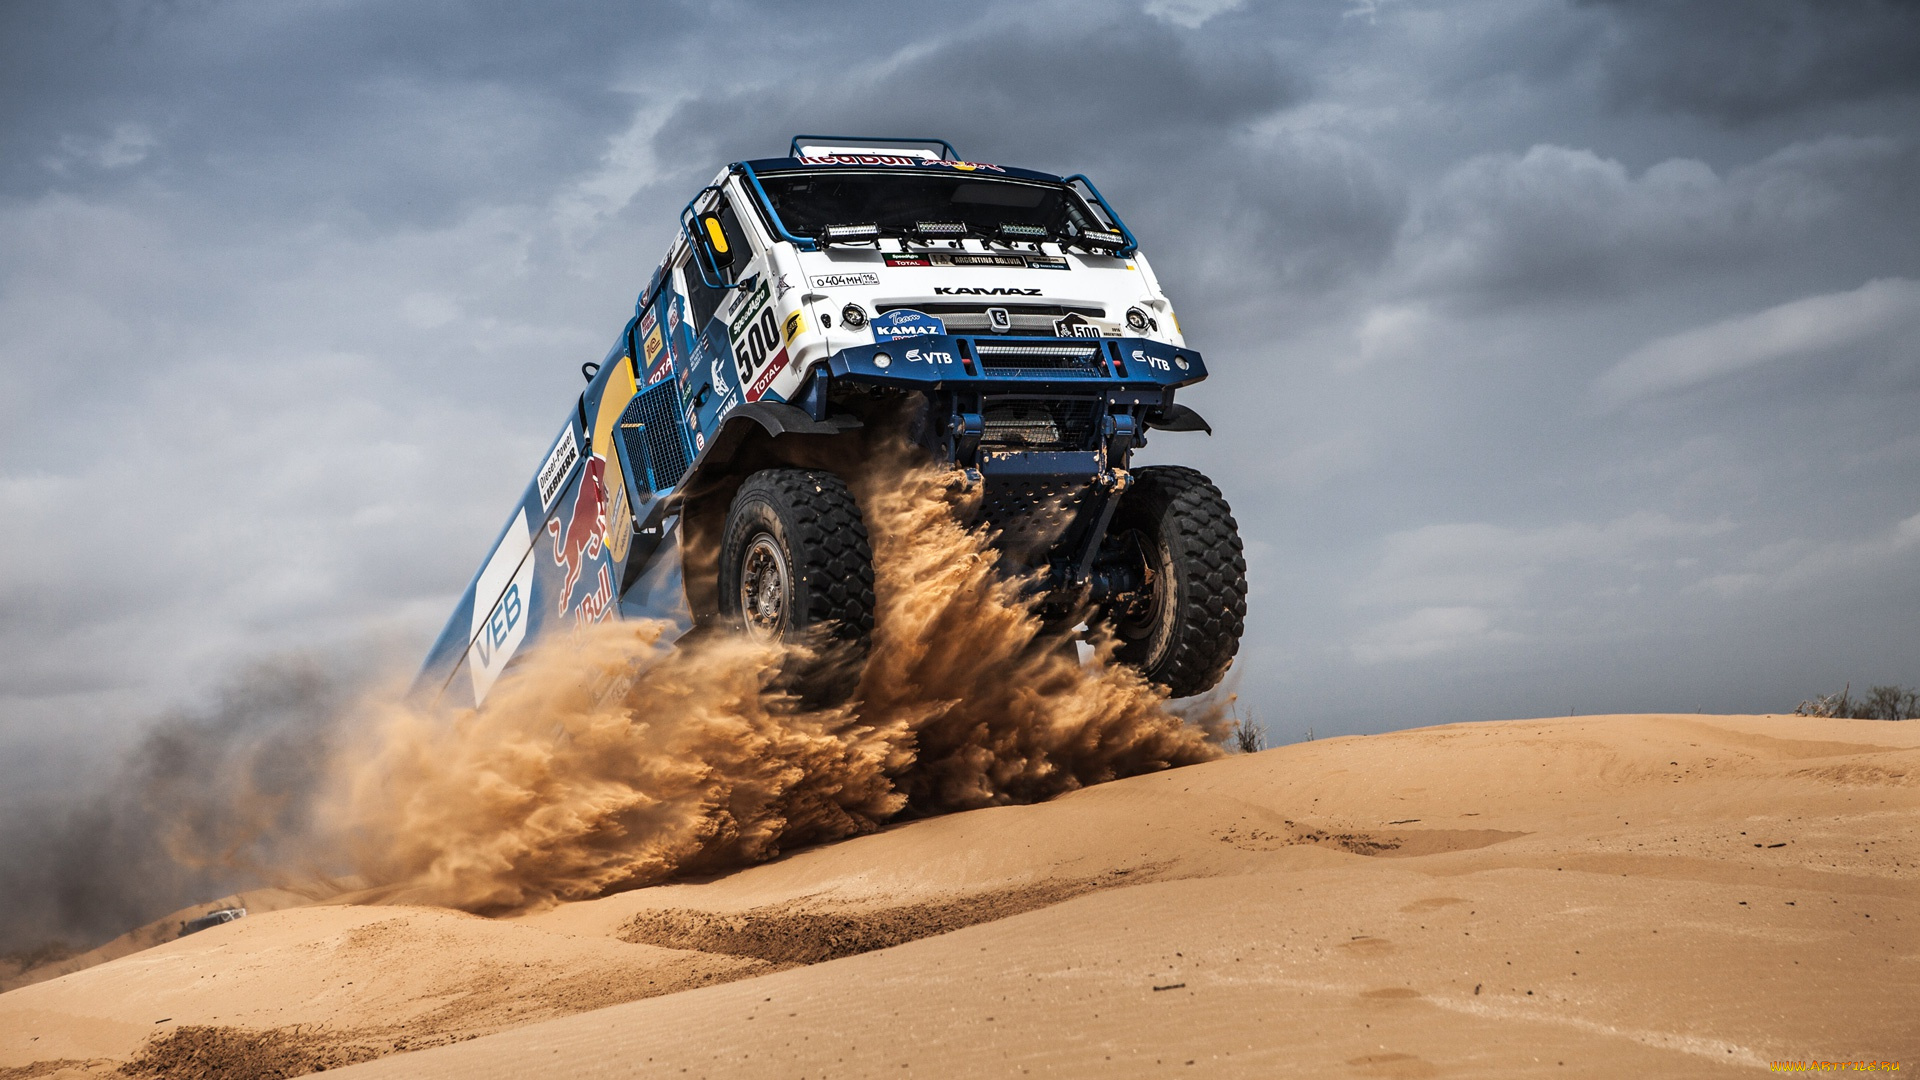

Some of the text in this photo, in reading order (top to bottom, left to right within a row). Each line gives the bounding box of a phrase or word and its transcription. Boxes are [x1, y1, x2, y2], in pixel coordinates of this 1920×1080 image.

[954, 256, 994, 264] ARGENTINA
[995, 257, 1022, 265] BOLIVIA
[934, 287, 1043, 296] KAMAZ
[889, 311, 921, 325] Team
[876, 326, 939, 335] KAMAZ
[735, 305, 780, 385] 500
[922, 351, 953, 364] VTB
[1146, 355, 1171, 371] VTB
[753, 364, 780, 394] TOTAL
[539, 431, 573, 488] Diesel-Power
[543, 446, 577, 506] LIEBHERR
[476, 583, 522, 669] VEB
